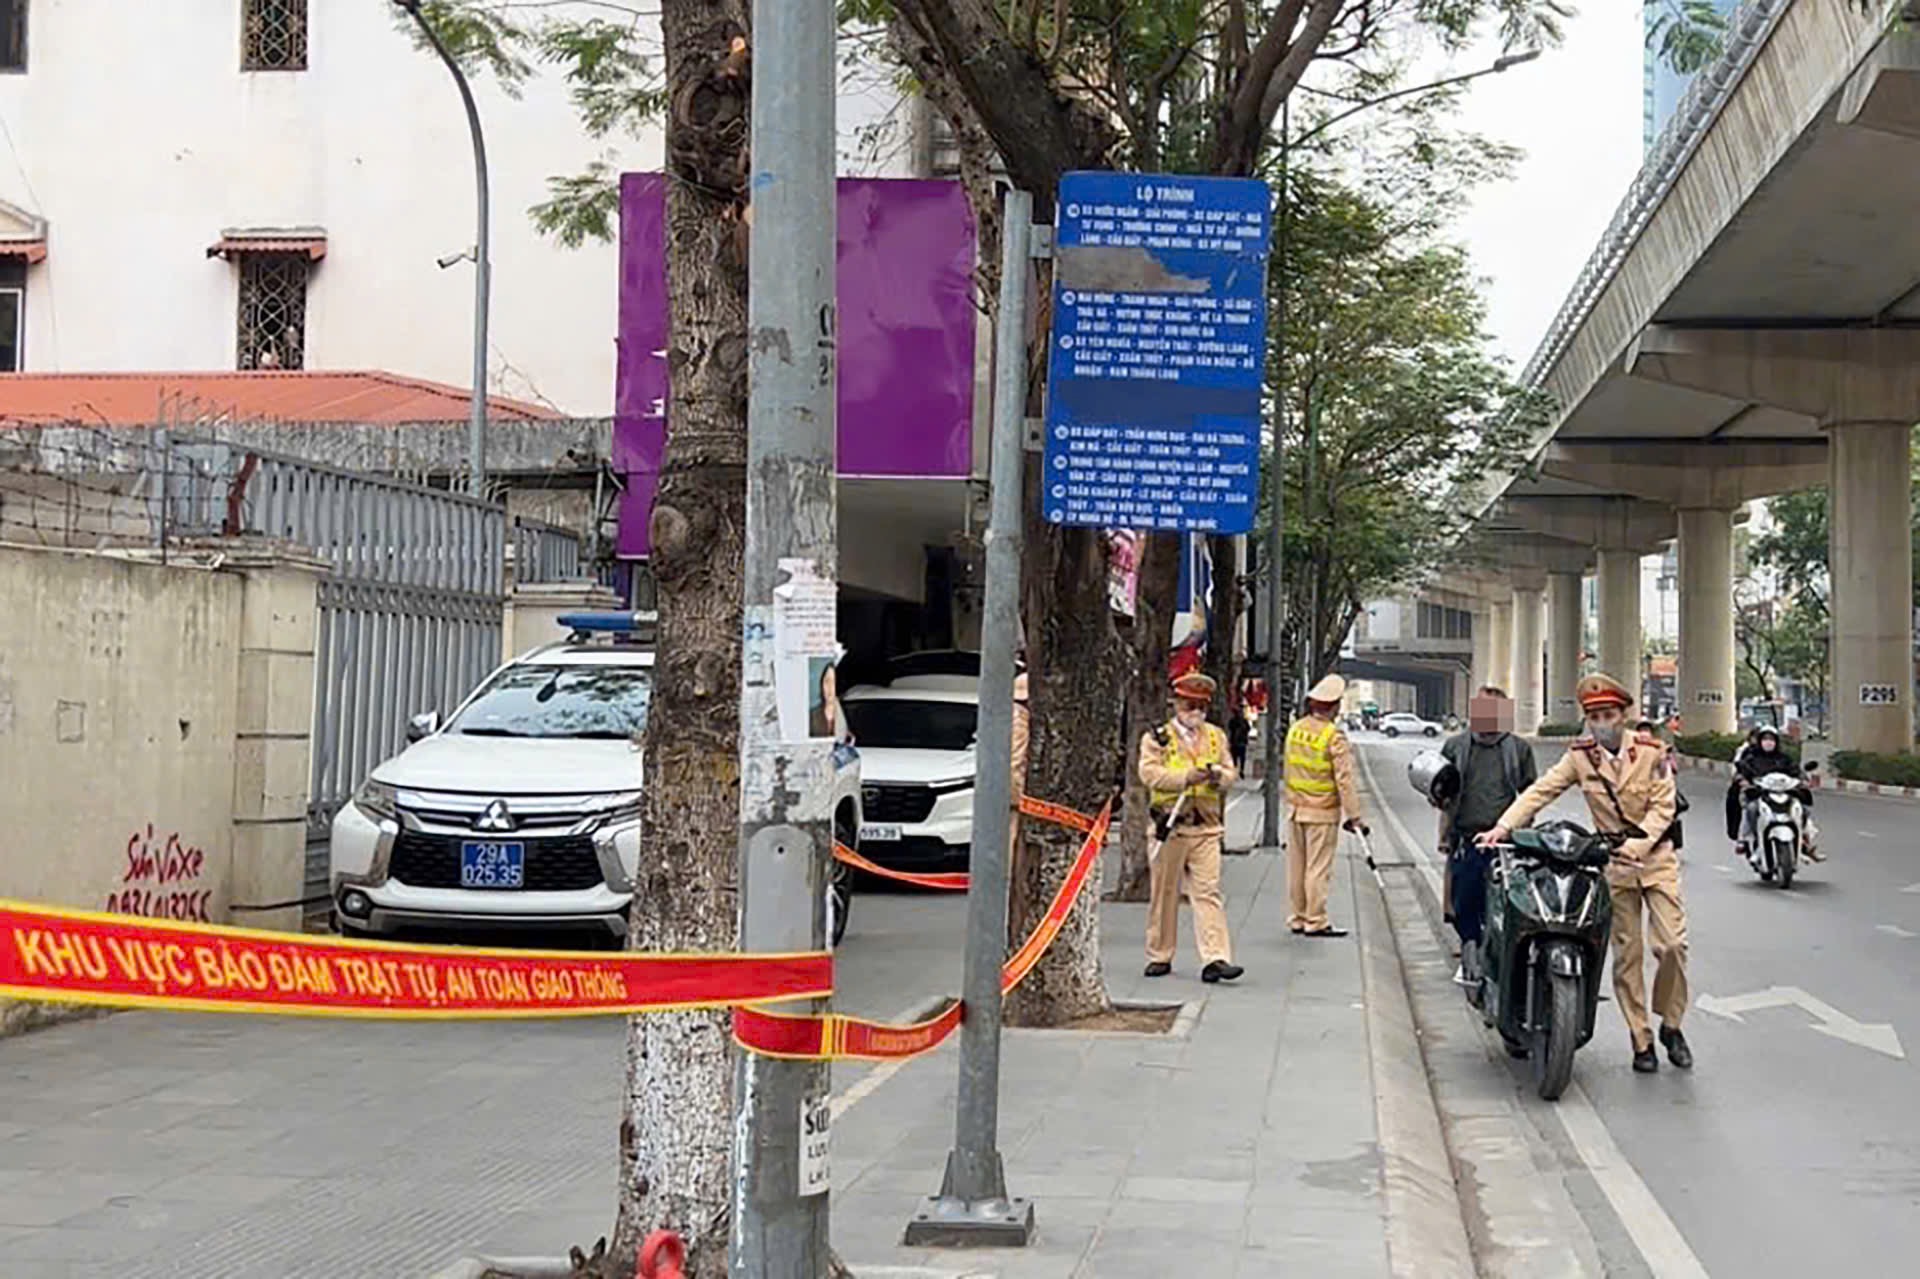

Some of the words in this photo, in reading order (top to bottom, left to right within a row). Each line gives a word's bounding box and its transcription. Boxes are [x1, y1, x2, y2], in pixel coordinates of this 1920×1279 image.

[1861, 686, 1897, 702] P295
[476, 844, 509, 864] 29A
[13, 927, 110, 982] KHU
[106, 936, 194, 993] VỰC
[193, 938, 269, 991] BẢO
[267, 944, 339, 995] ĐẢM
[336, 957, 403, 1005] TRẬT
[446, 966, 477, 1001] AN
[475, 963, 530, 1002] TOÀN
[530, 968, 574, 1000] GIAO
[572, 963, 629, 1001] THÔNG
